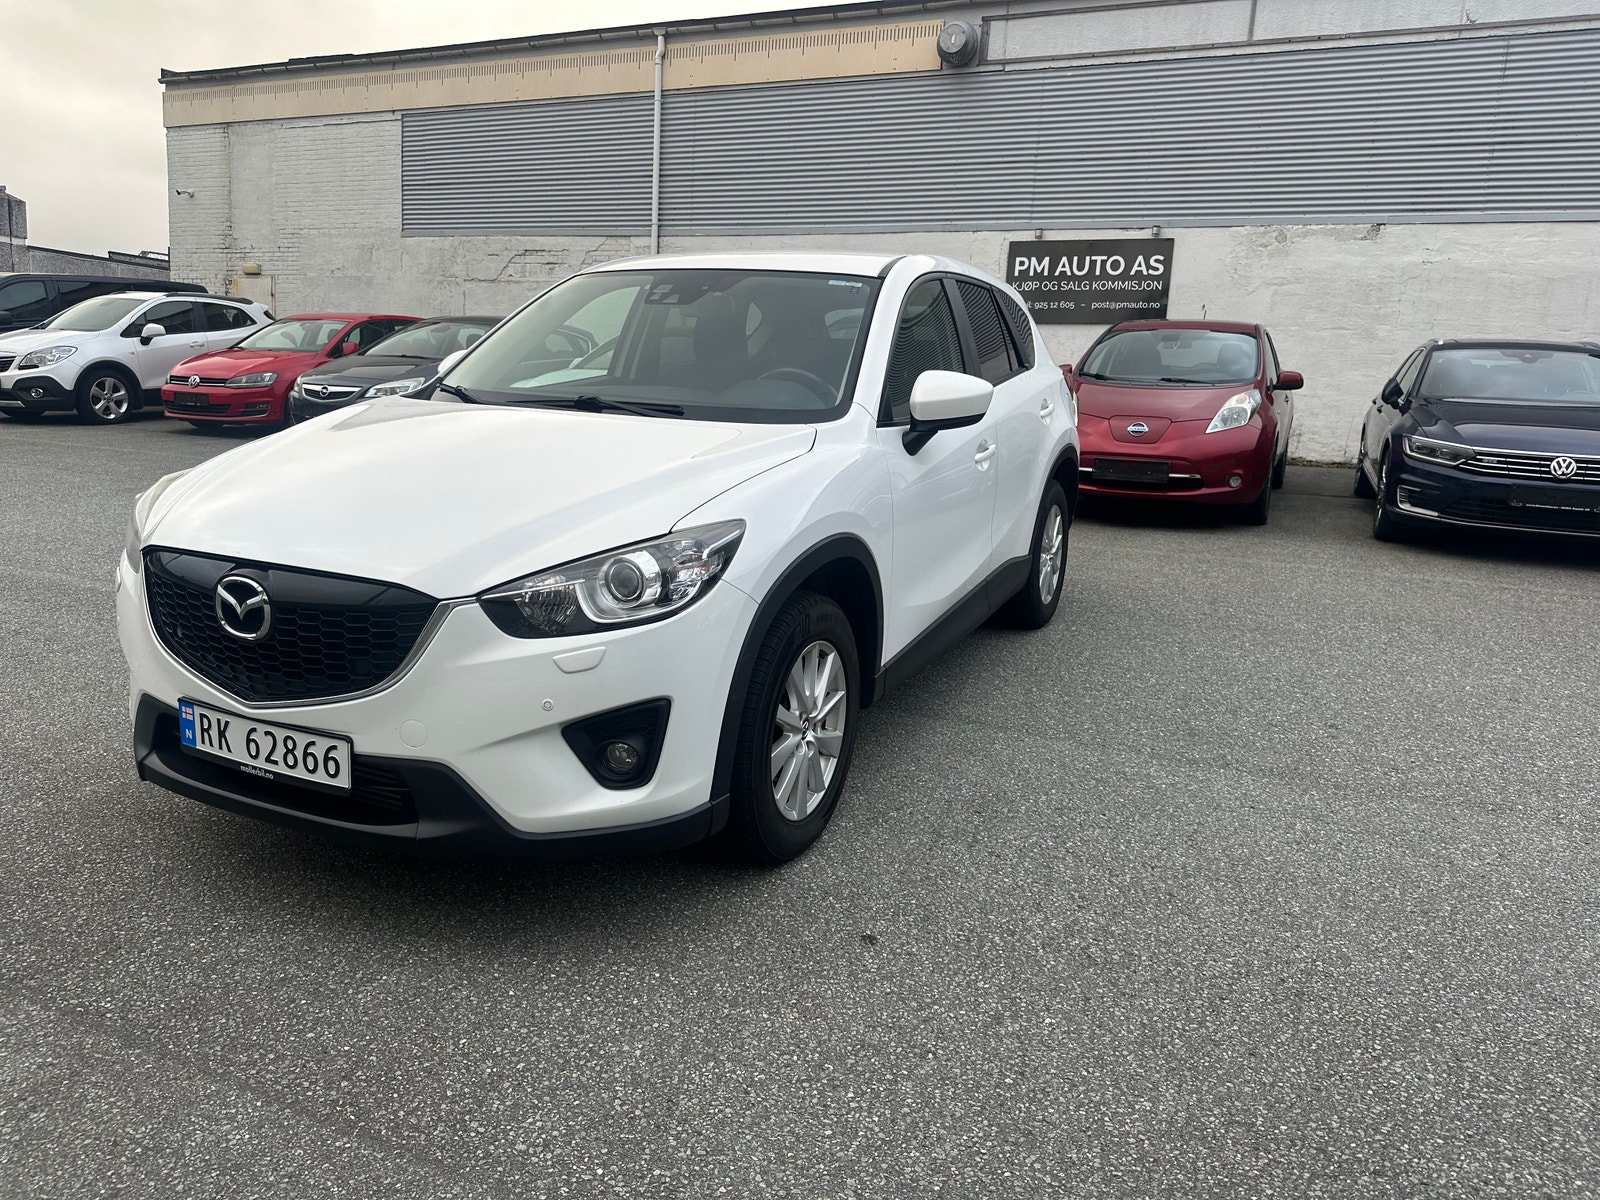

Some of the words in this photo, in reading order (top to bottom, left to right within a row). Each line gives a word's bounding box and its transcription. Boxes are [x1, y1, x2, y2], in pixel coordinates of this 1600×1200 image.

[1014, 256, 1050, 276] PM
[1054, 255, 1126, 276] AUTO
[1130, 255, 1165, 276] AS
[1012, 281, 1039, 292] KJØP
[1041, 281, 1058, 291] OG
[1060, 280, 1090, 291] SALG
[1092, 280, 1163, 291] KOMMISJON
[1050, 301, 1058, 309] 12
[1060, 301, 1075, 309] 605
[1091, 301, 1161, 310] post@pmauto.no
[185, 728, 193, 740] N
[199, 712, 233, 754] RK
[245, 727, 341, 779] 62866
